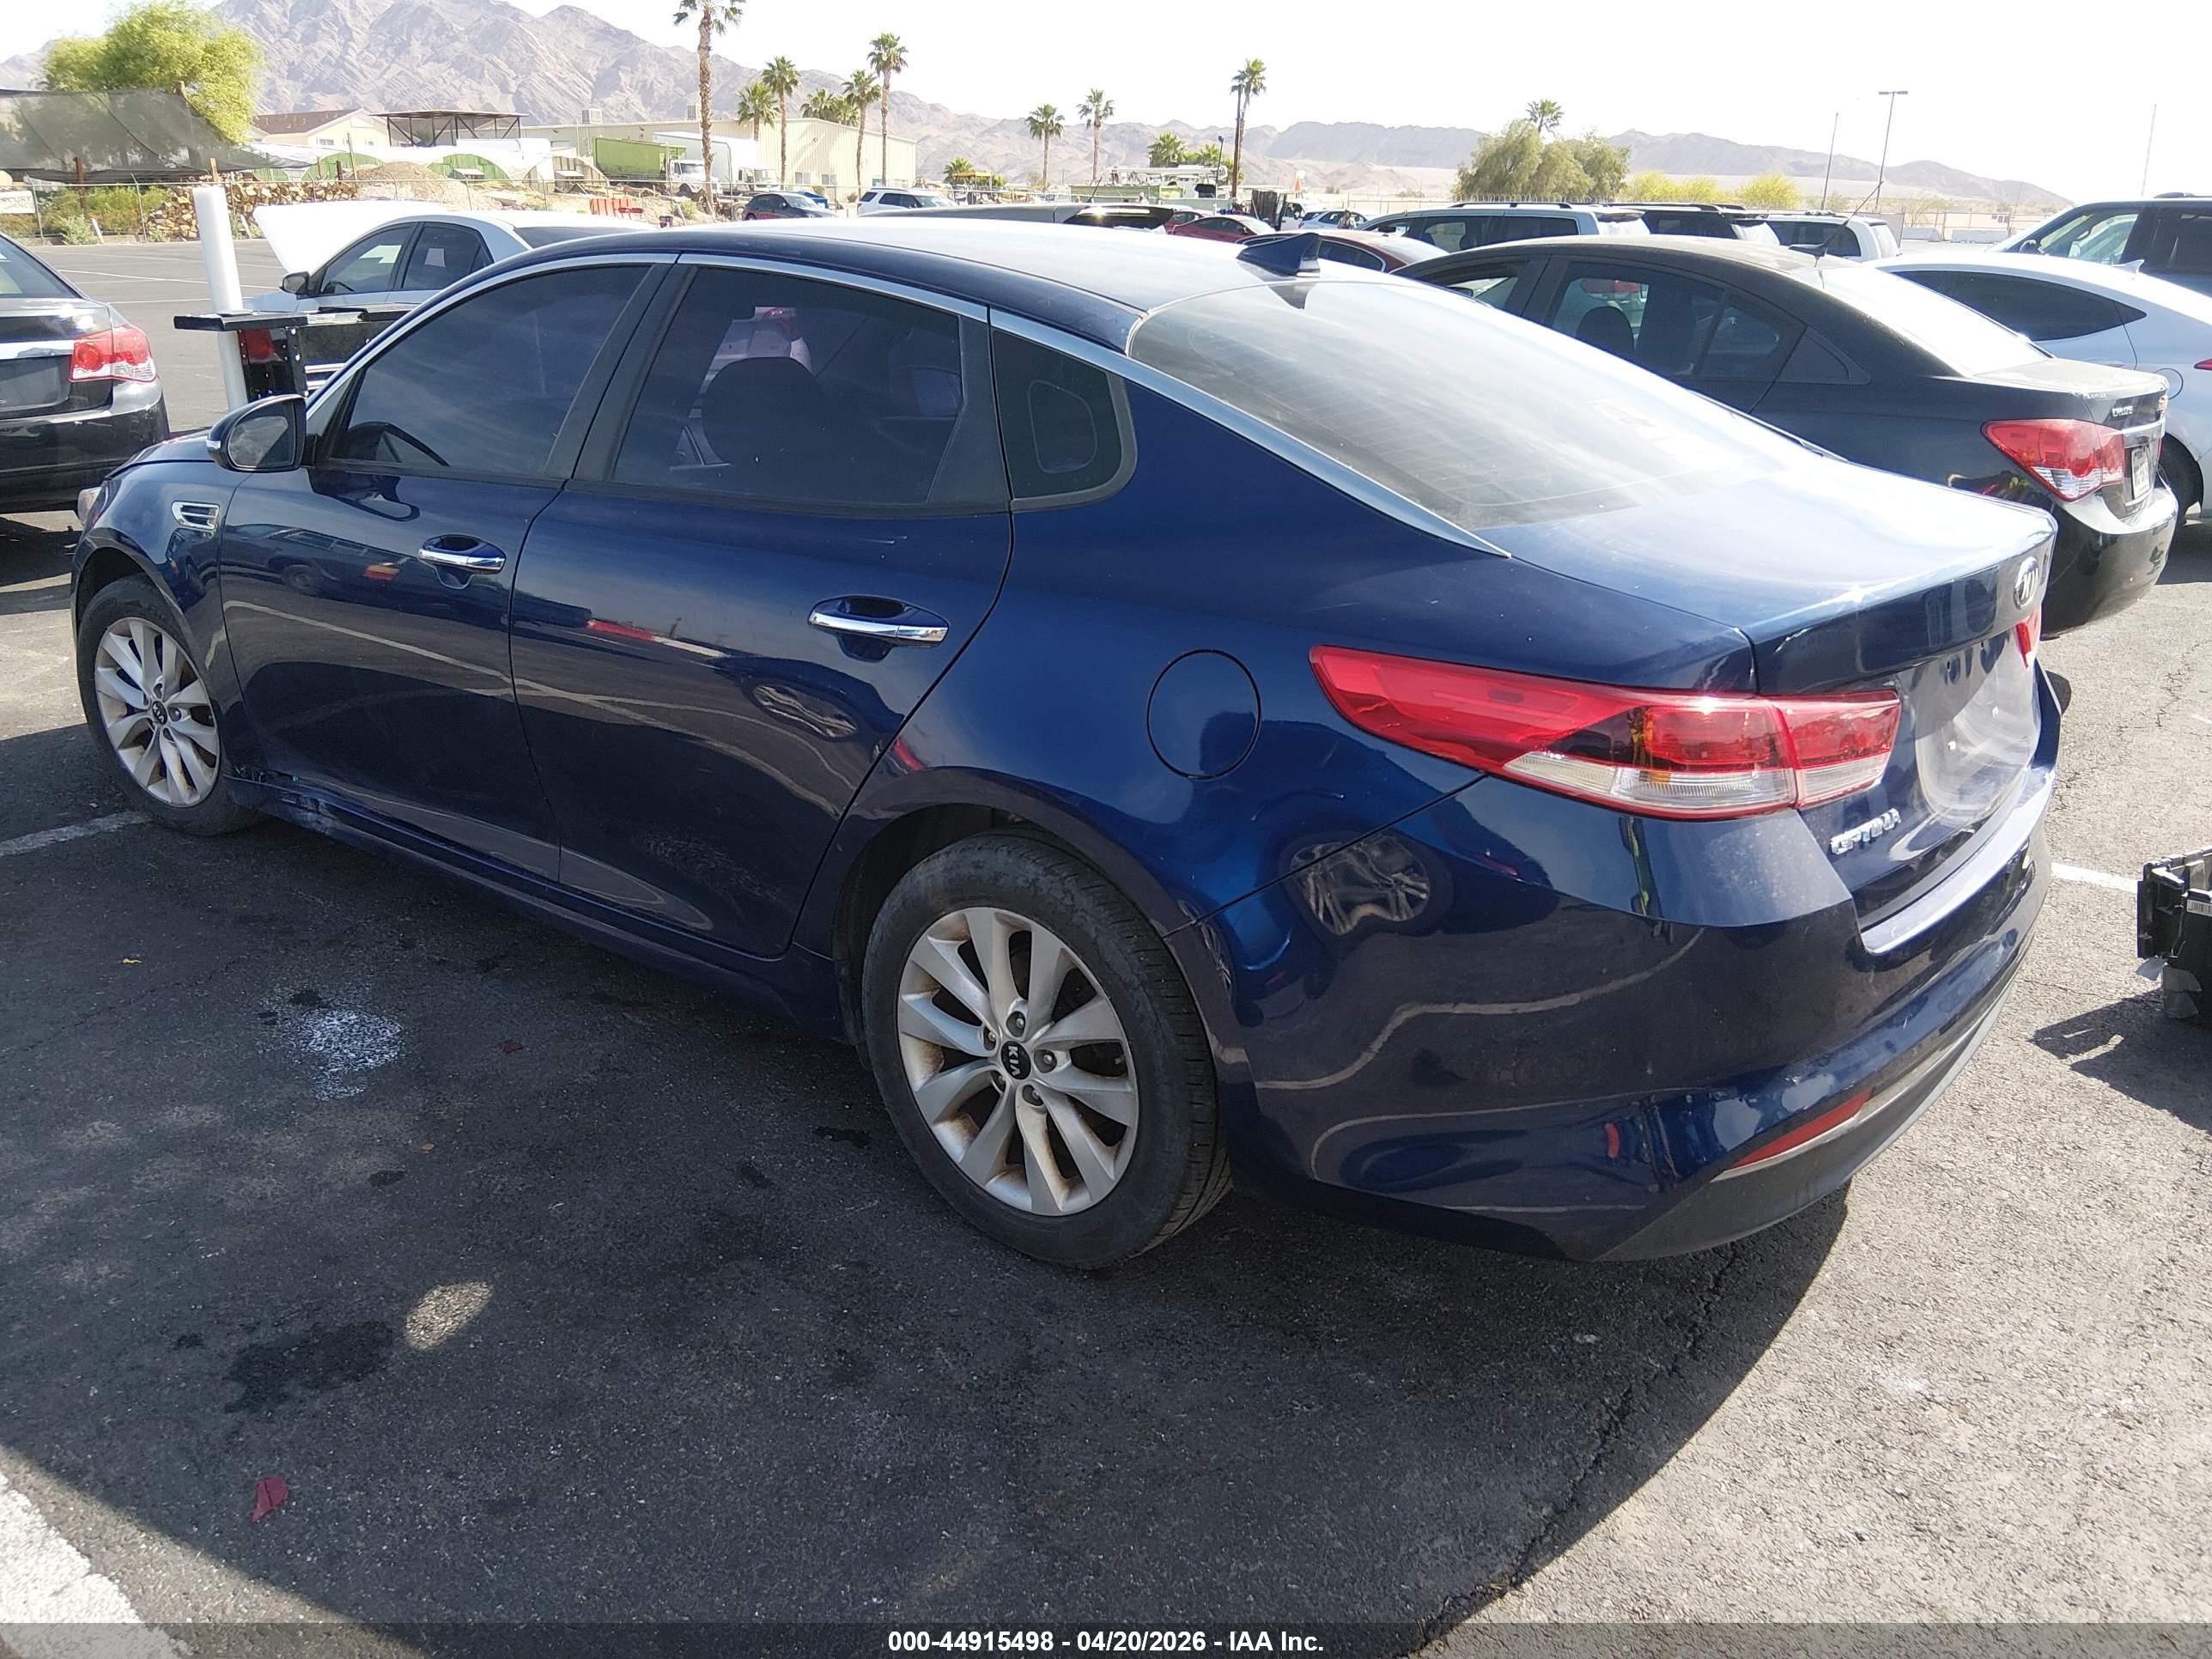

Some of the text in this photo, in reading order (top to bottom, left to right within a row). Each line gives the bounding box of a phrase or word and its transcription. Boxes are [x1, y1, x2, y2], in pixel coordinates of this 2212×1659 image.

[153, 702, 165, 724] KIA
[1830, 807, 1902, 855] OPTIMA
[1007, 1045, 1022, 1076] KIA
